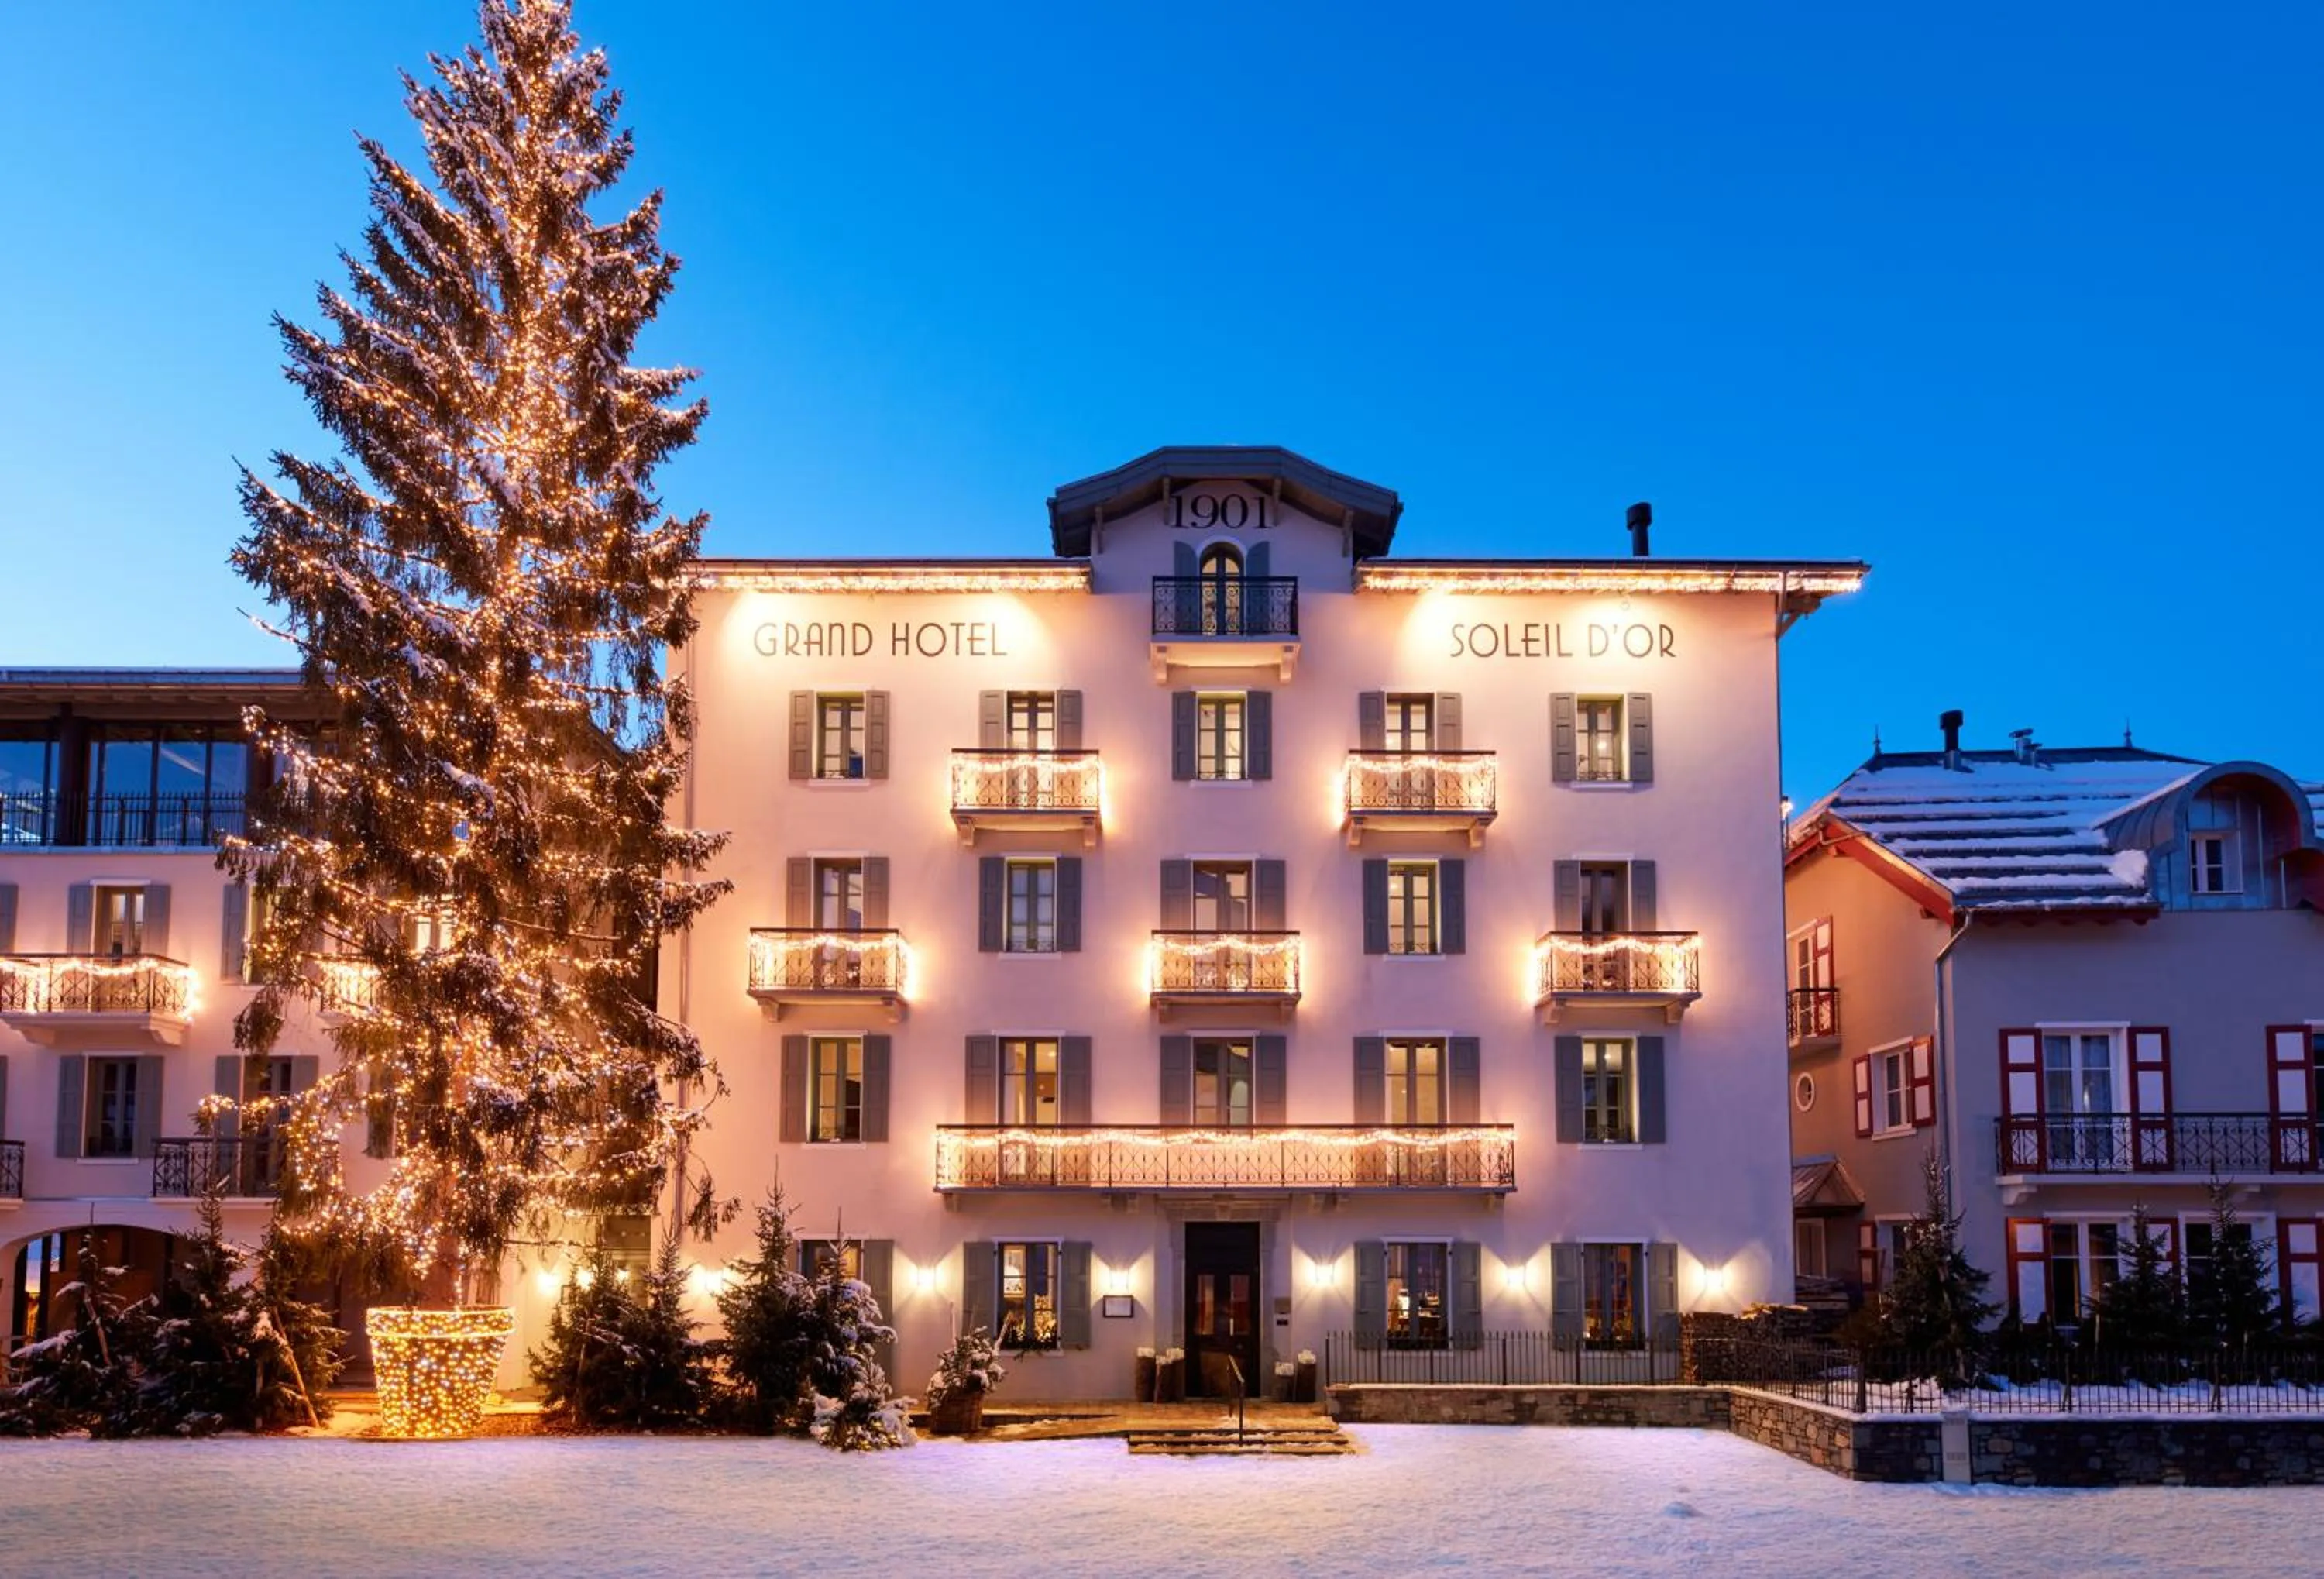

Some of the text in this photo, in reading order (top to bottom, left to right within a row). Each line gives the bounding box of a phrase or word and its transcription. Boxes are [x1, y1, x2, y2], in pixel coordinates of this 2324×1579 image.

[1170, 494, 1272, 528] 1901
[754, 622, 1008, 657] GRAND HOTEL
[1450, 623, 1676, 658] SOLEIL D'OR
